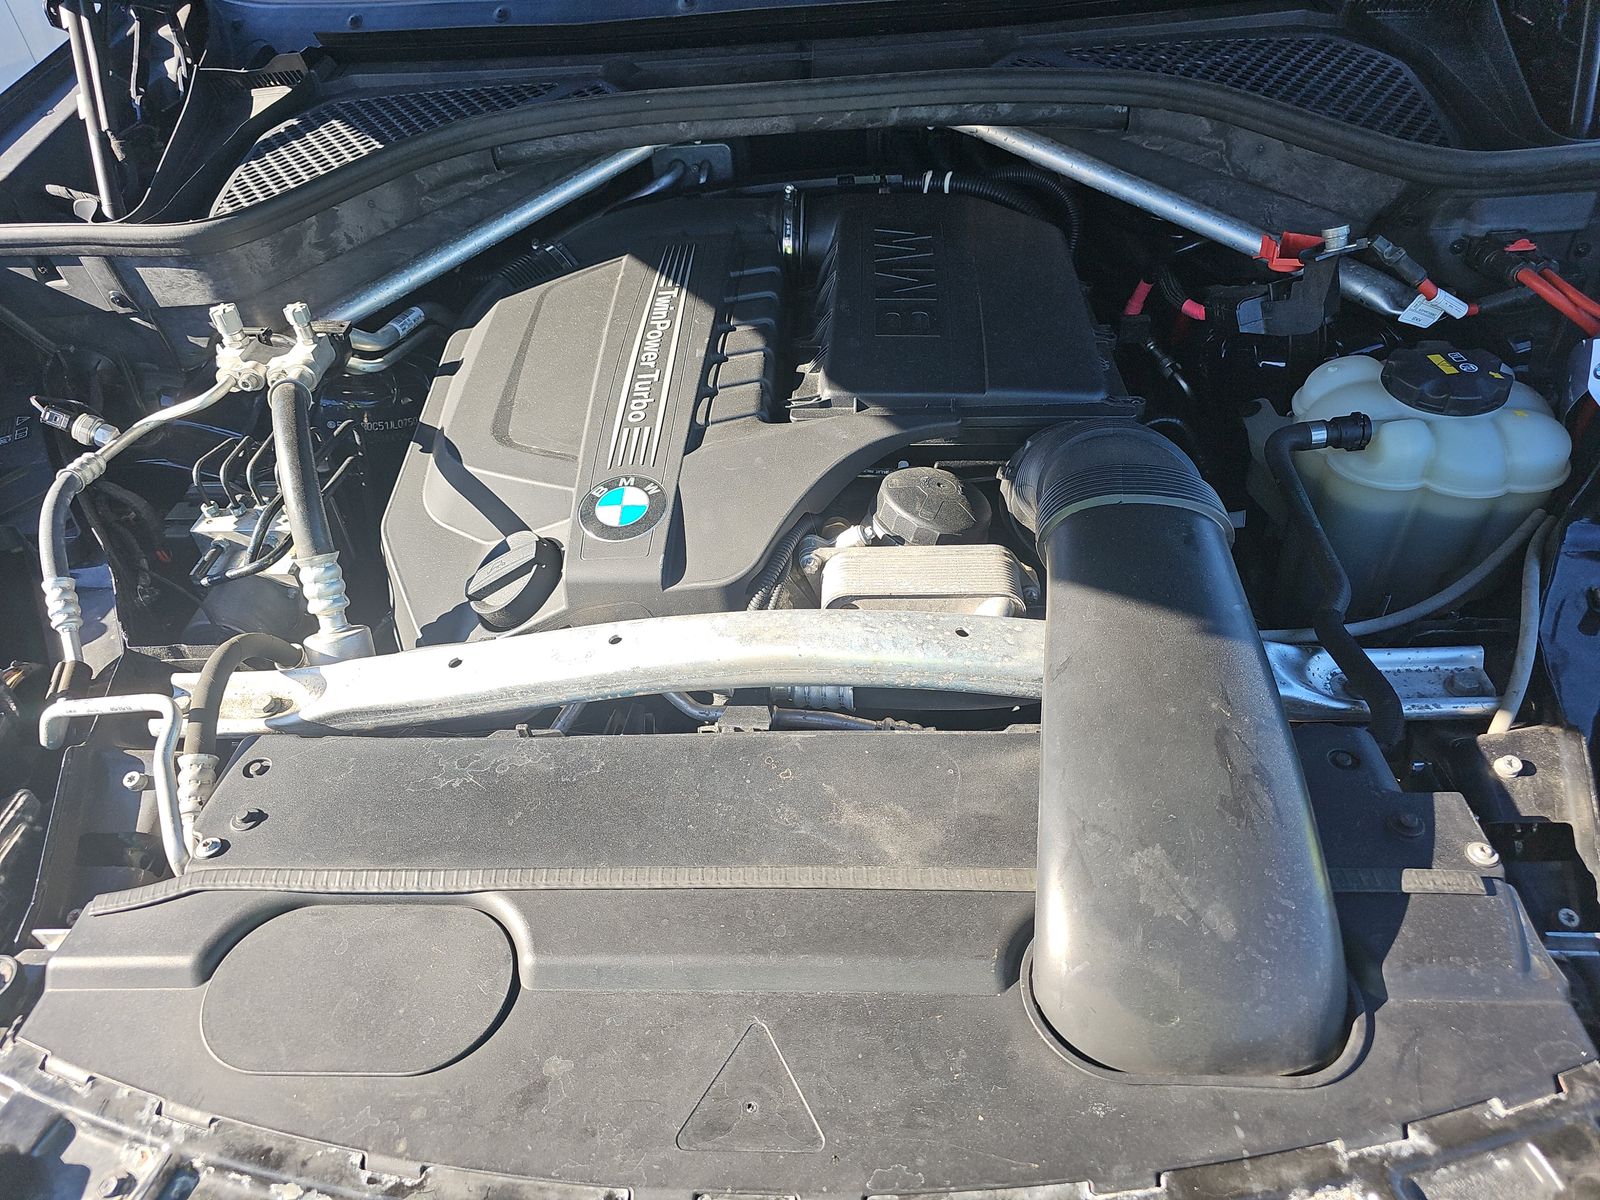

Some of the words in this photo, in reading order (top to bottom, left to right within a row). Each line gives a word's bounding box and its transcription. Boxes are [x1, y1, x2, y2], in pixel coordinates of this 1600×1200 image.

[874, 226, 940, 338] BMW
[639, 287, 680, 369] TwinPower
[627, 369, 661, 423] Turbo
[591, 477, 661, 504] BMW
